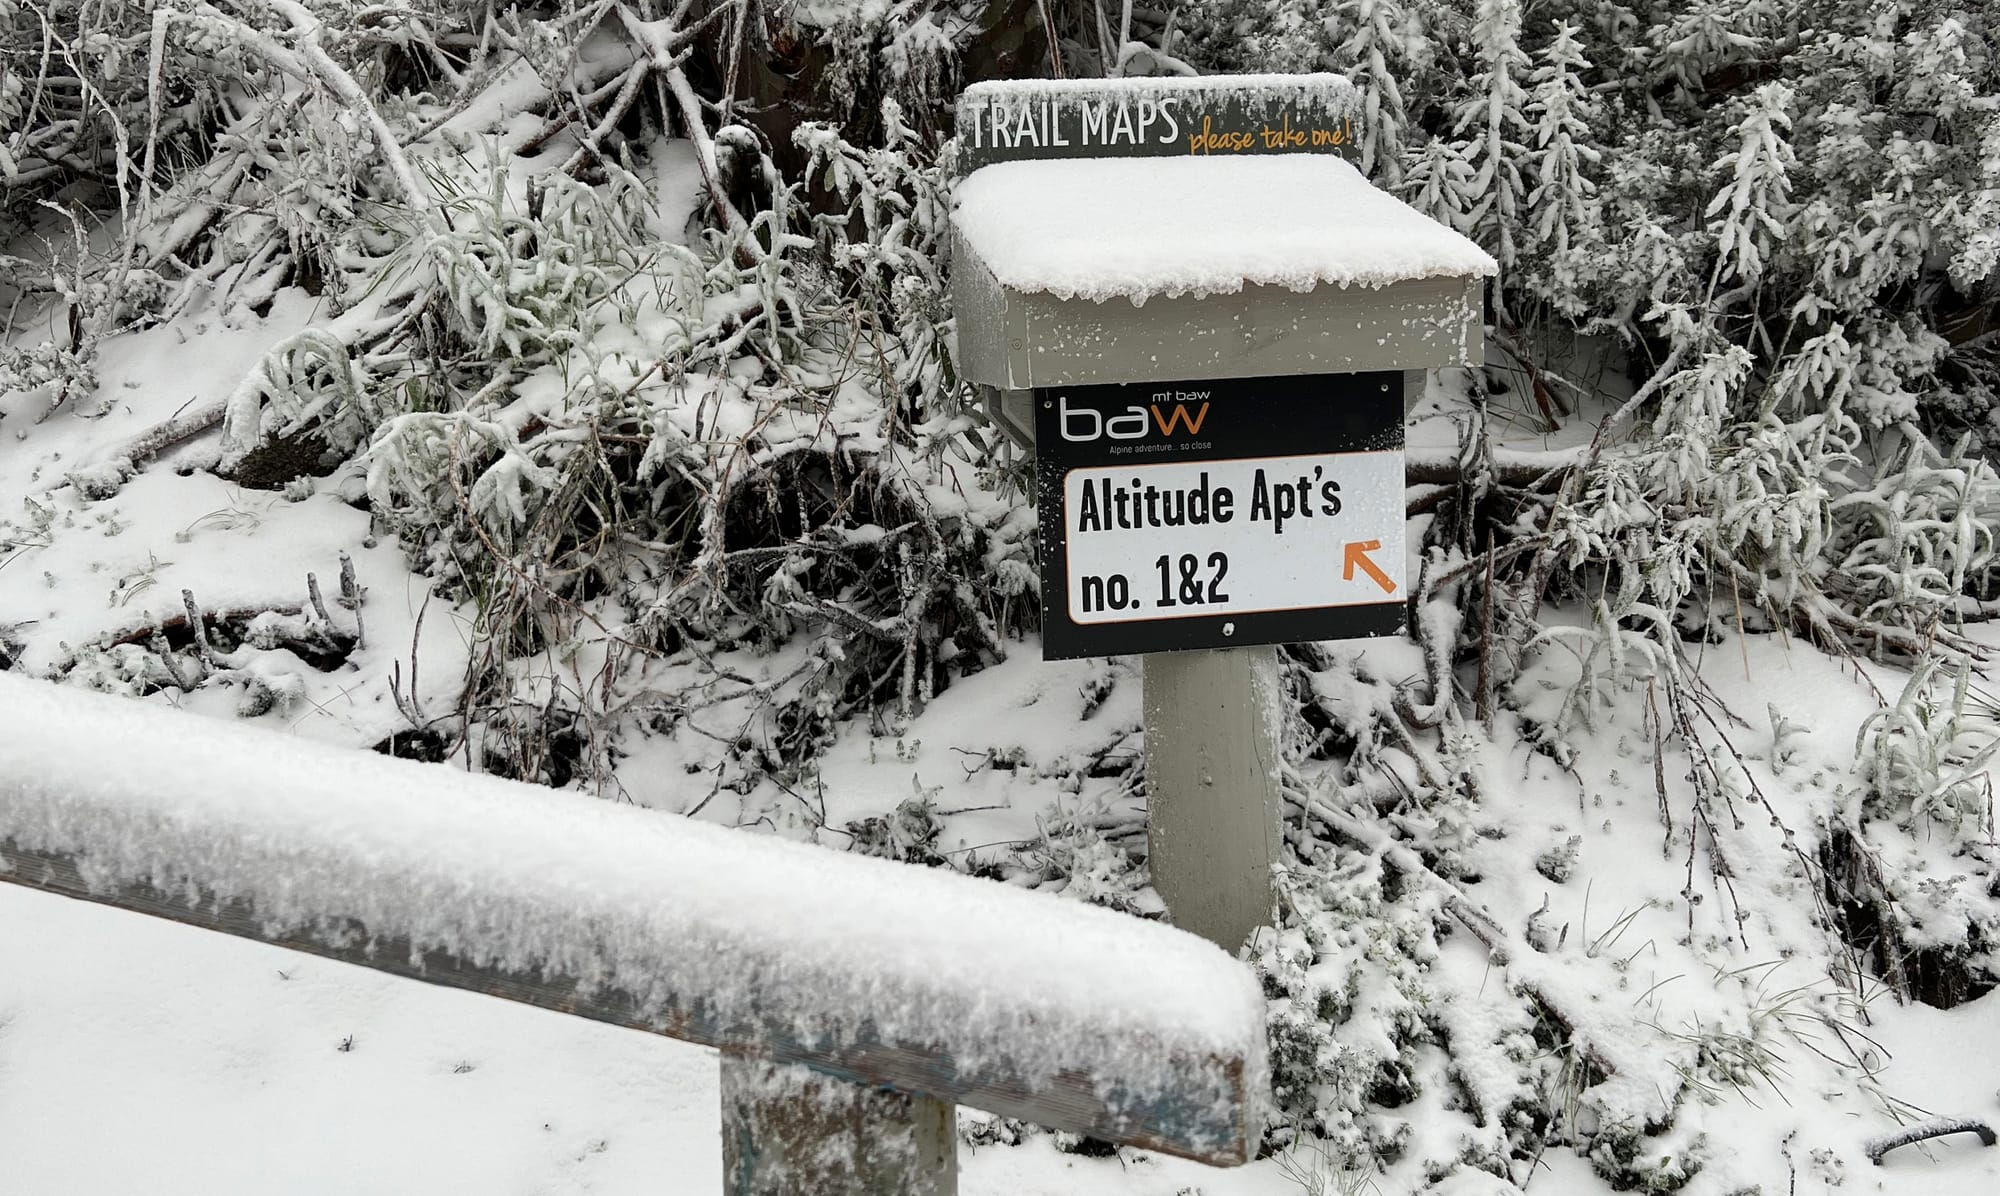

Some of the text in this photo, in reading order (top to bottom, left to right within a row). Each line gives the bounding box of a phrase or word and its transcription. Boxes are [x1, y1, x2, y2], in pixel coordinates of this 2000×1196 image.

[967, 98, 1178, 149] TRAIL MAPS
[1188, 112, 1352, 155] please take one!
[1059, 396, 1210, 442] baw
[1152, 391, 1210, 402] mt baw
[1109, 445, 1133, 456] Alpine
[1180, 443, 1190, 451] so
[1191, 441, 1212, 450] close
[1078, 465, 1342, 534] Altitude Apt's
[1081, 551, 1230, 613] no. 1&2
